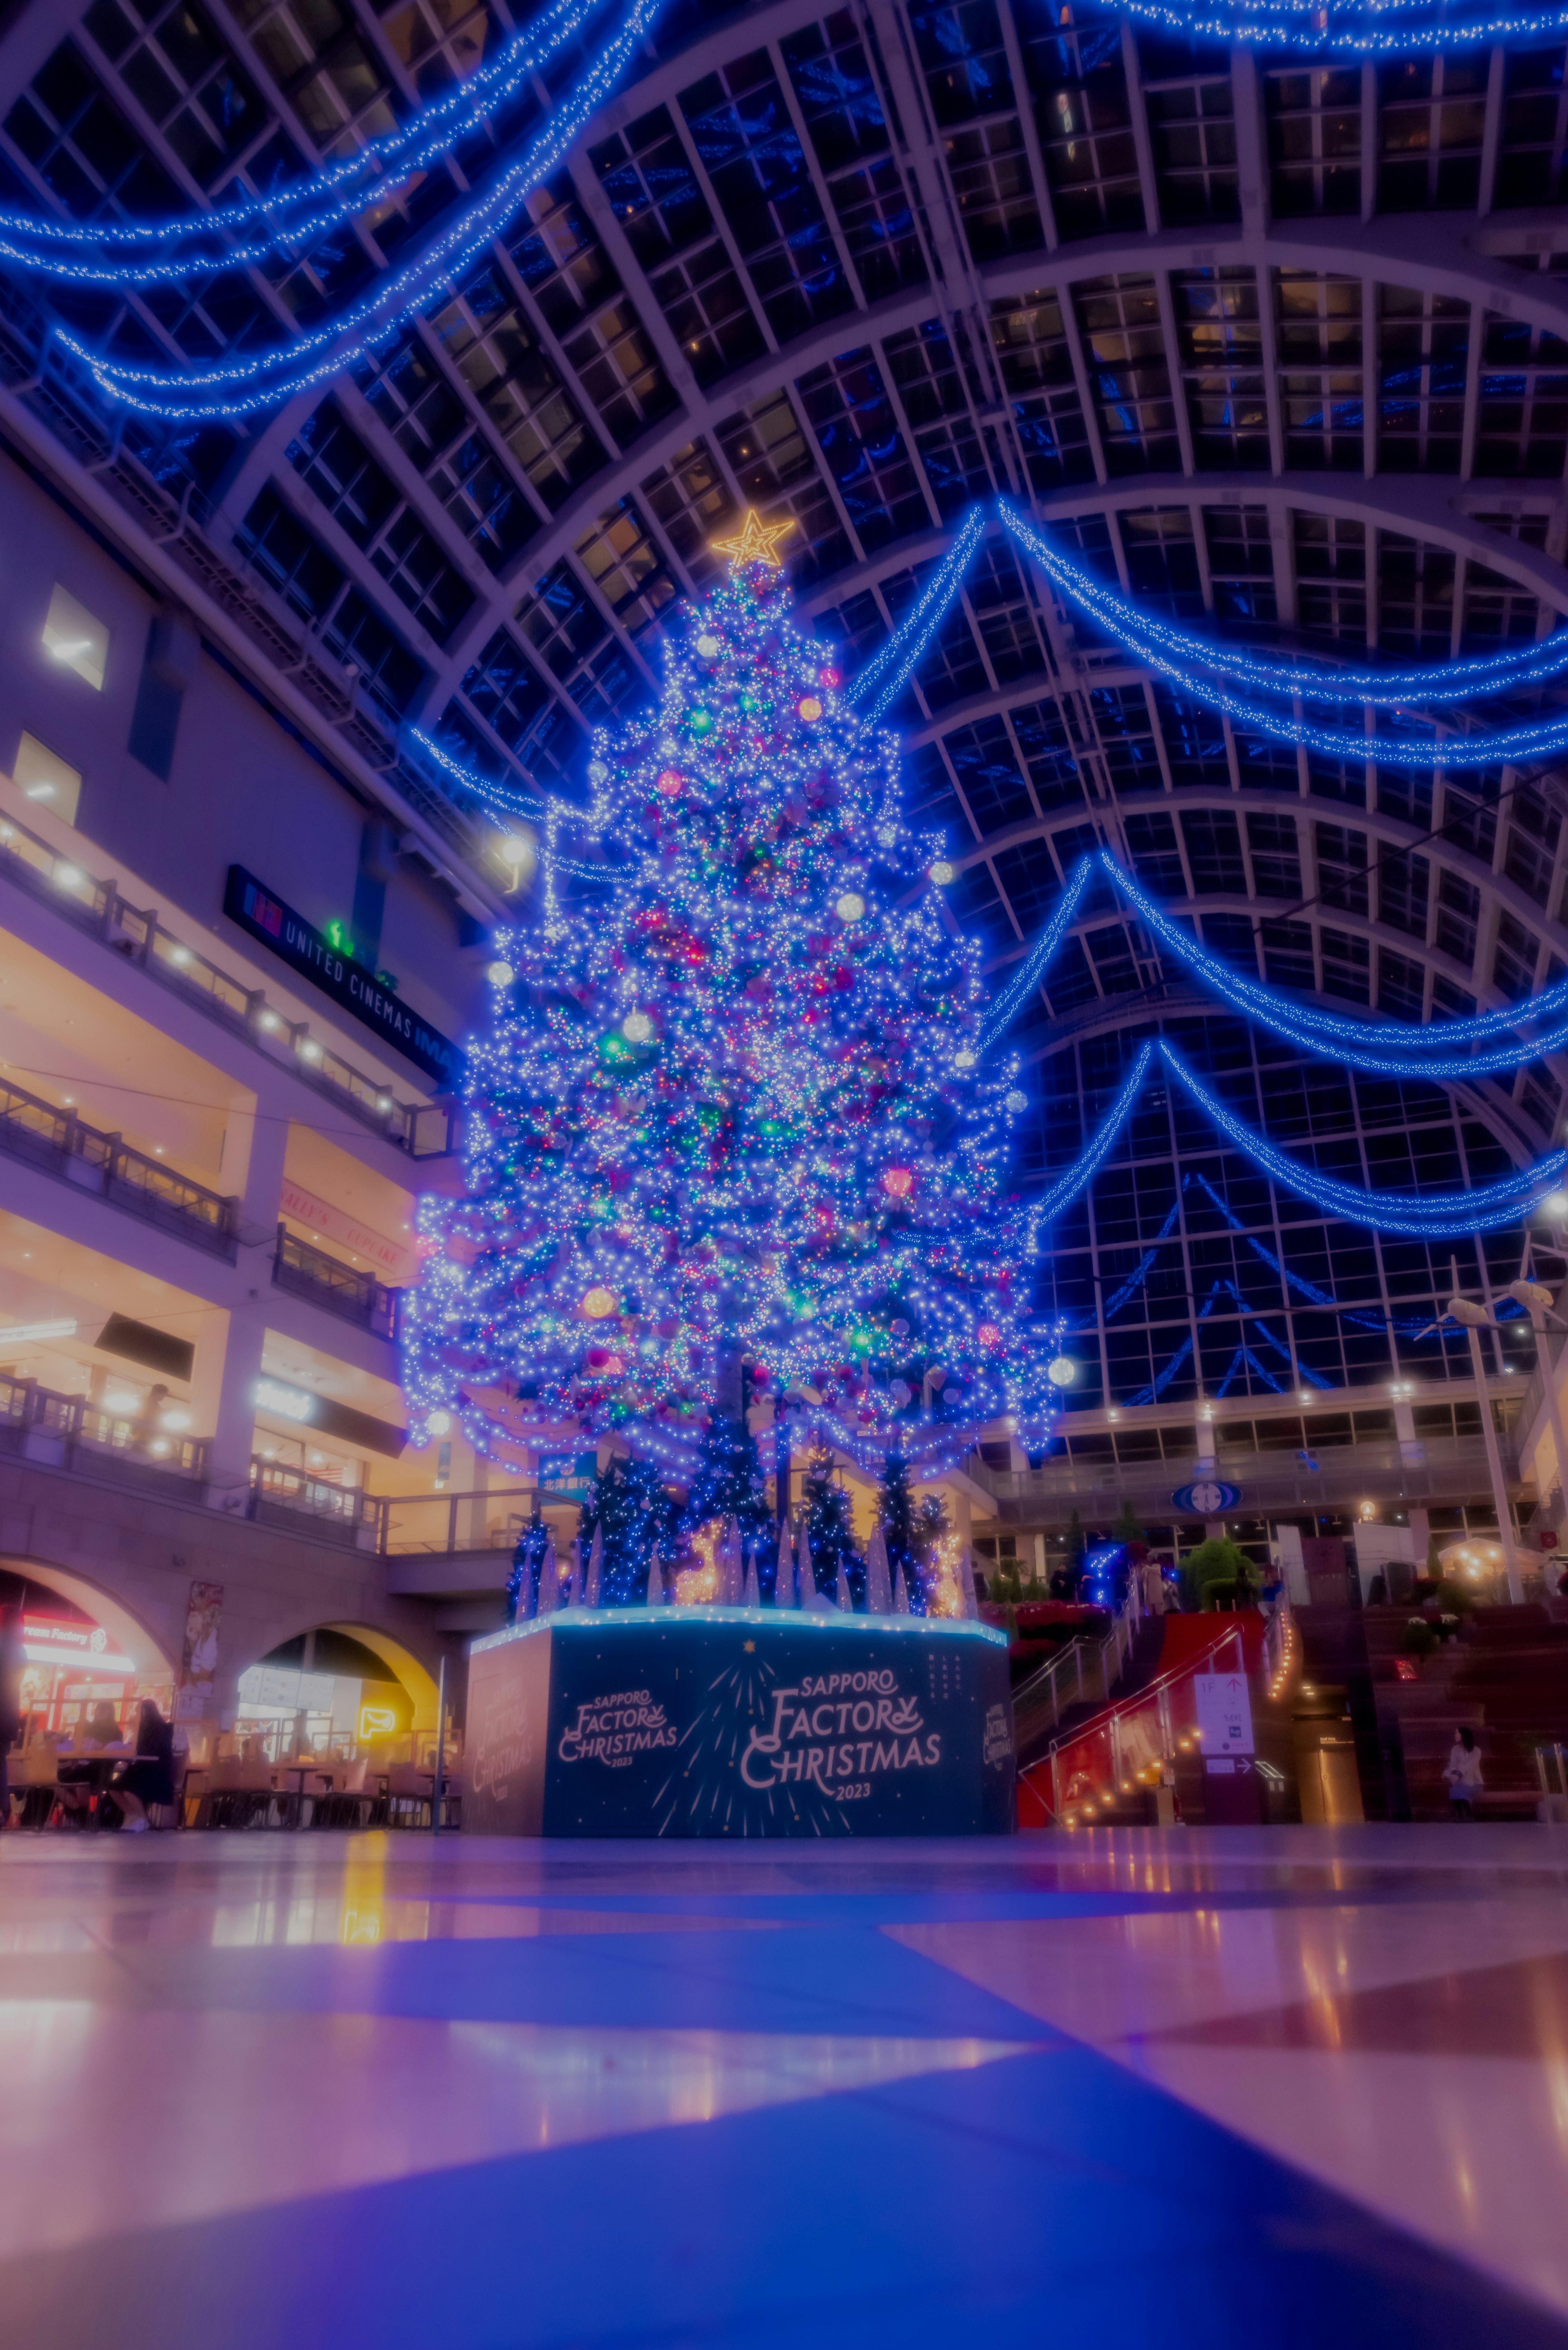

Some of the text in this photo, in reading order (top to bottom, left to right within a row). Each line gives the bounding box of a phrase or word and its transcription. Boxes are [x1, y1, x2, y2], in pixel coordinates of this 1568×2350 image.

[286, 921, 455, 1069] UNITED CINEMAS IMA
[281, 1188, 399, 1265] SALLY'S CUPCAKE
[544, 1476, 590, 1491] 北洋銀行
[24, 1626, 88, 1645] ream Factory
[800, 1669, 899, 1697] SAPPORO
[1201, 1682, 1215, 1694] 1F
[594, 1689, 653, 1710] SAPPORO
[567, 1704, 667, 1737] FACTORY
[755, 1688, 924, 1743] FACTORY
[559, 1727, 678, 1765] CHRISTMAS
[740, 1725, 942, 1796] CHRISTMAS
[473, 1734, 533, 1798] CHRISTMAS
[611, 1756, 633, 1768] 2023
[835, 1782, 871, 1801] 2023
